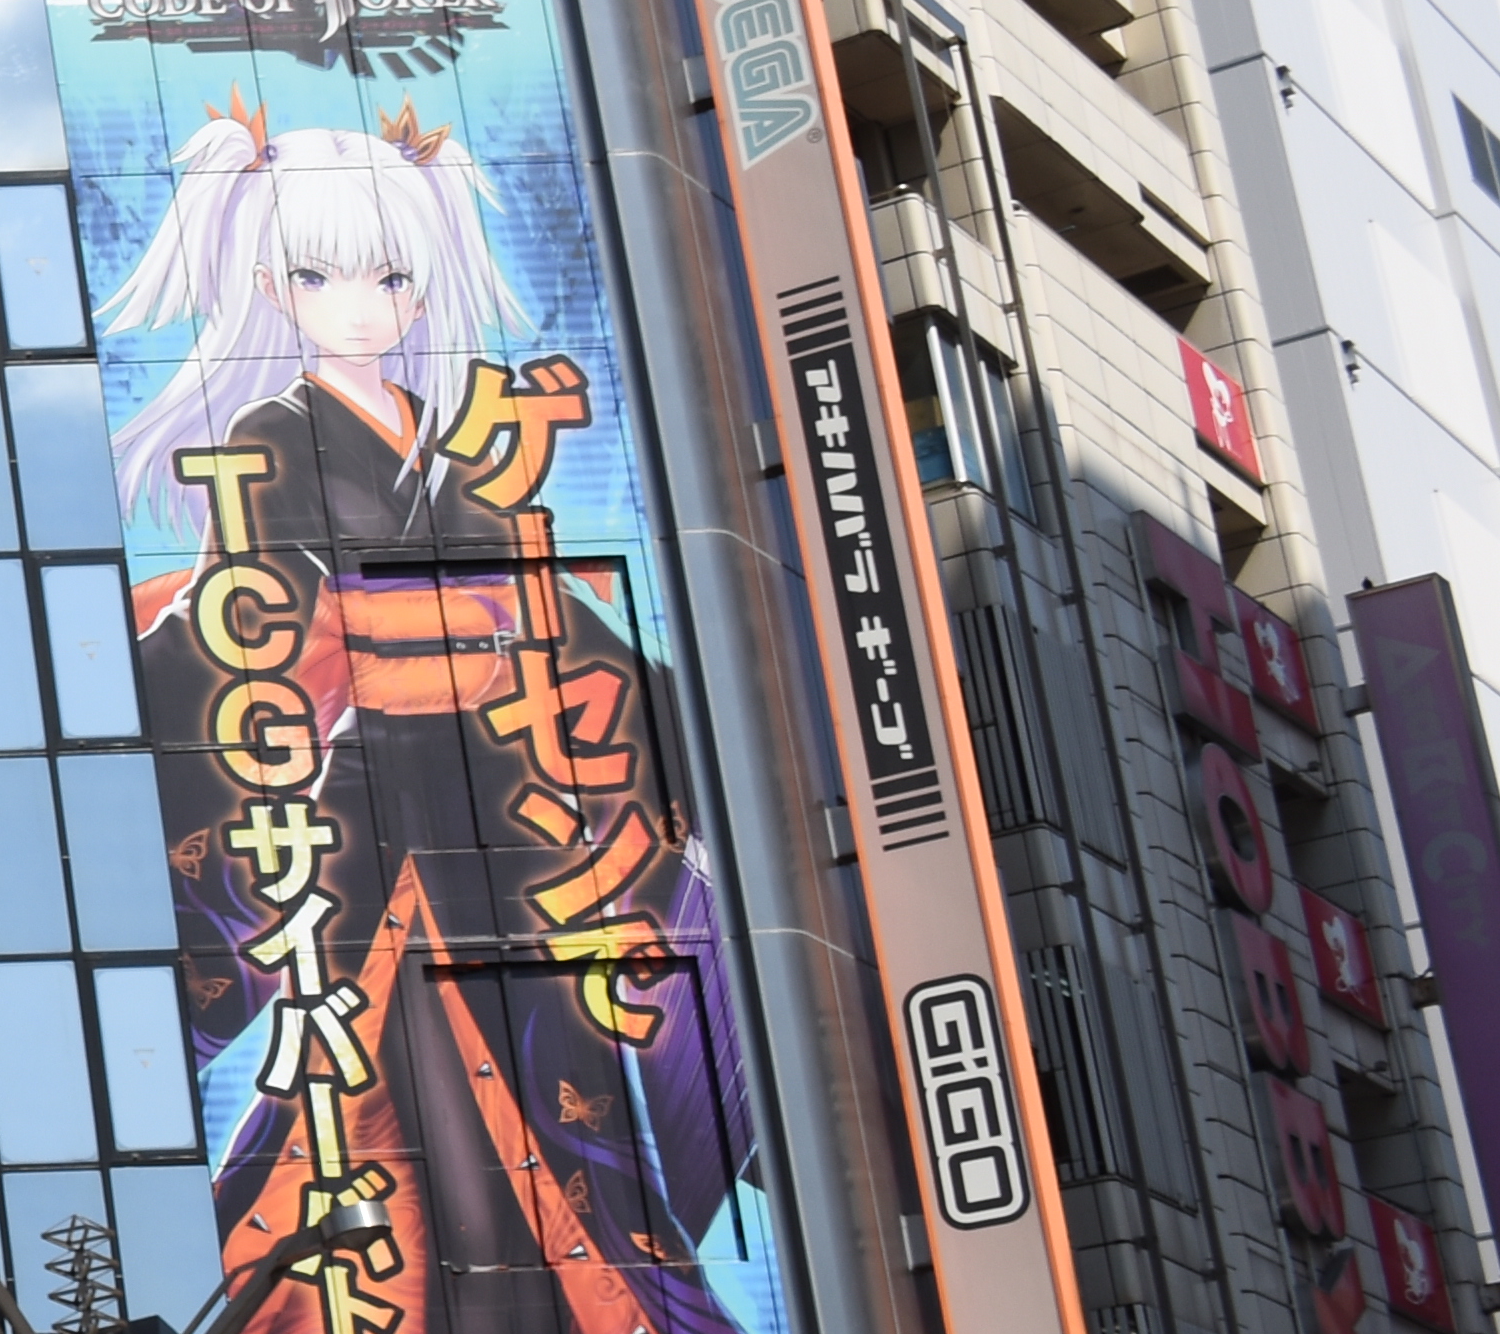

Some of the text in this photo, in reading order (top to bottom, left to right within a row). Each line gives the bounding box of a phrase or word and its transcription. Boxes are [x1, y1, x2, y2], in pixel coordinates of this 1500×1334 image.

[438, 355, 667, 1047] ゲーセンで
[804, 359, 881, 596] アキハバラ
